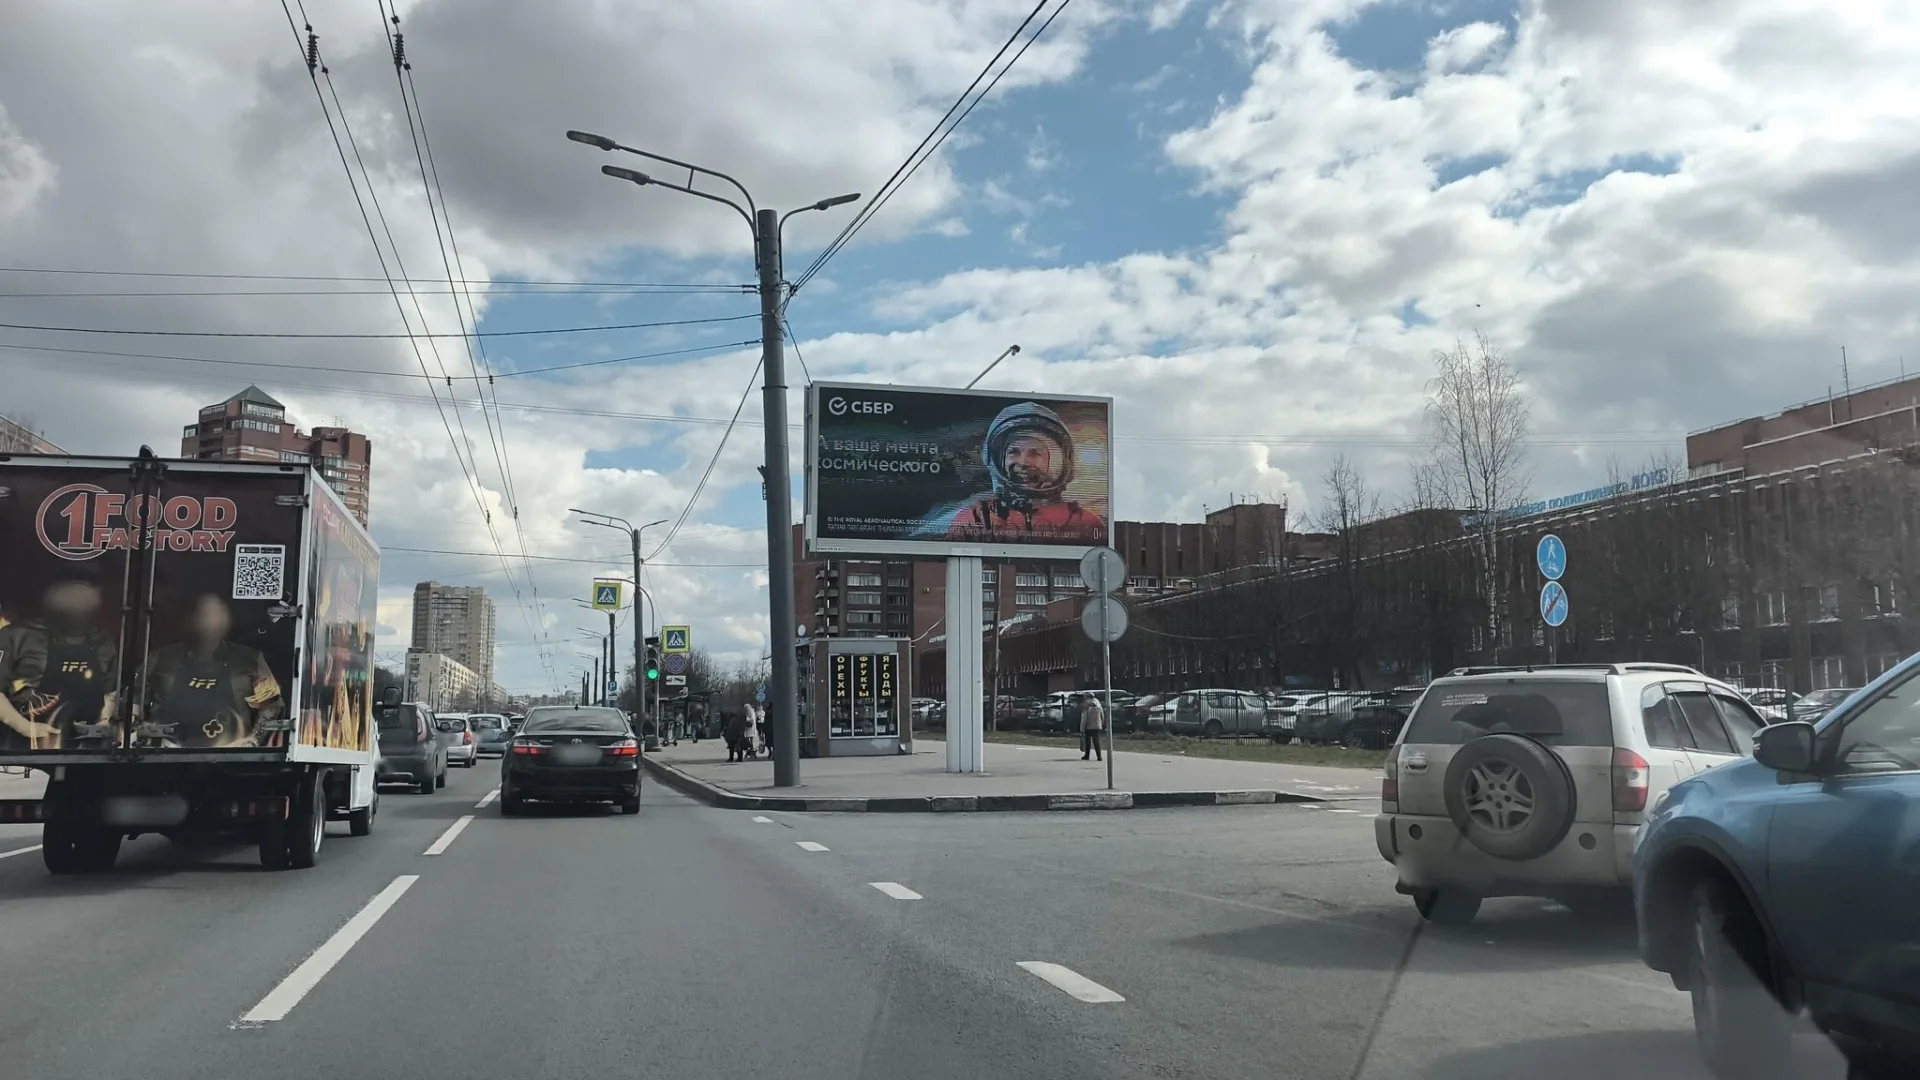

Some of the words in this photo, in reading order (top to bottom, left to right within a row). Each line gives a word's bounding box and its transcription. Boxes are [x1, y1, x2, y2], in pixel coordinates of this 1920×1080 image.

[851, 400, 894, 415] СБЕР
[833, 439, 880, 452] ваша
[885, 441, 939, 455] мечта
[93, 493, 237, 530] FOOD
[92, 528, 236, 552] FACTORY
[836, 655, 846, 697] ОРЕХИ
[859, 656, 869, 697] ФРУКТЫ
[881, 655, 891, 697] ЯГОДЫ
